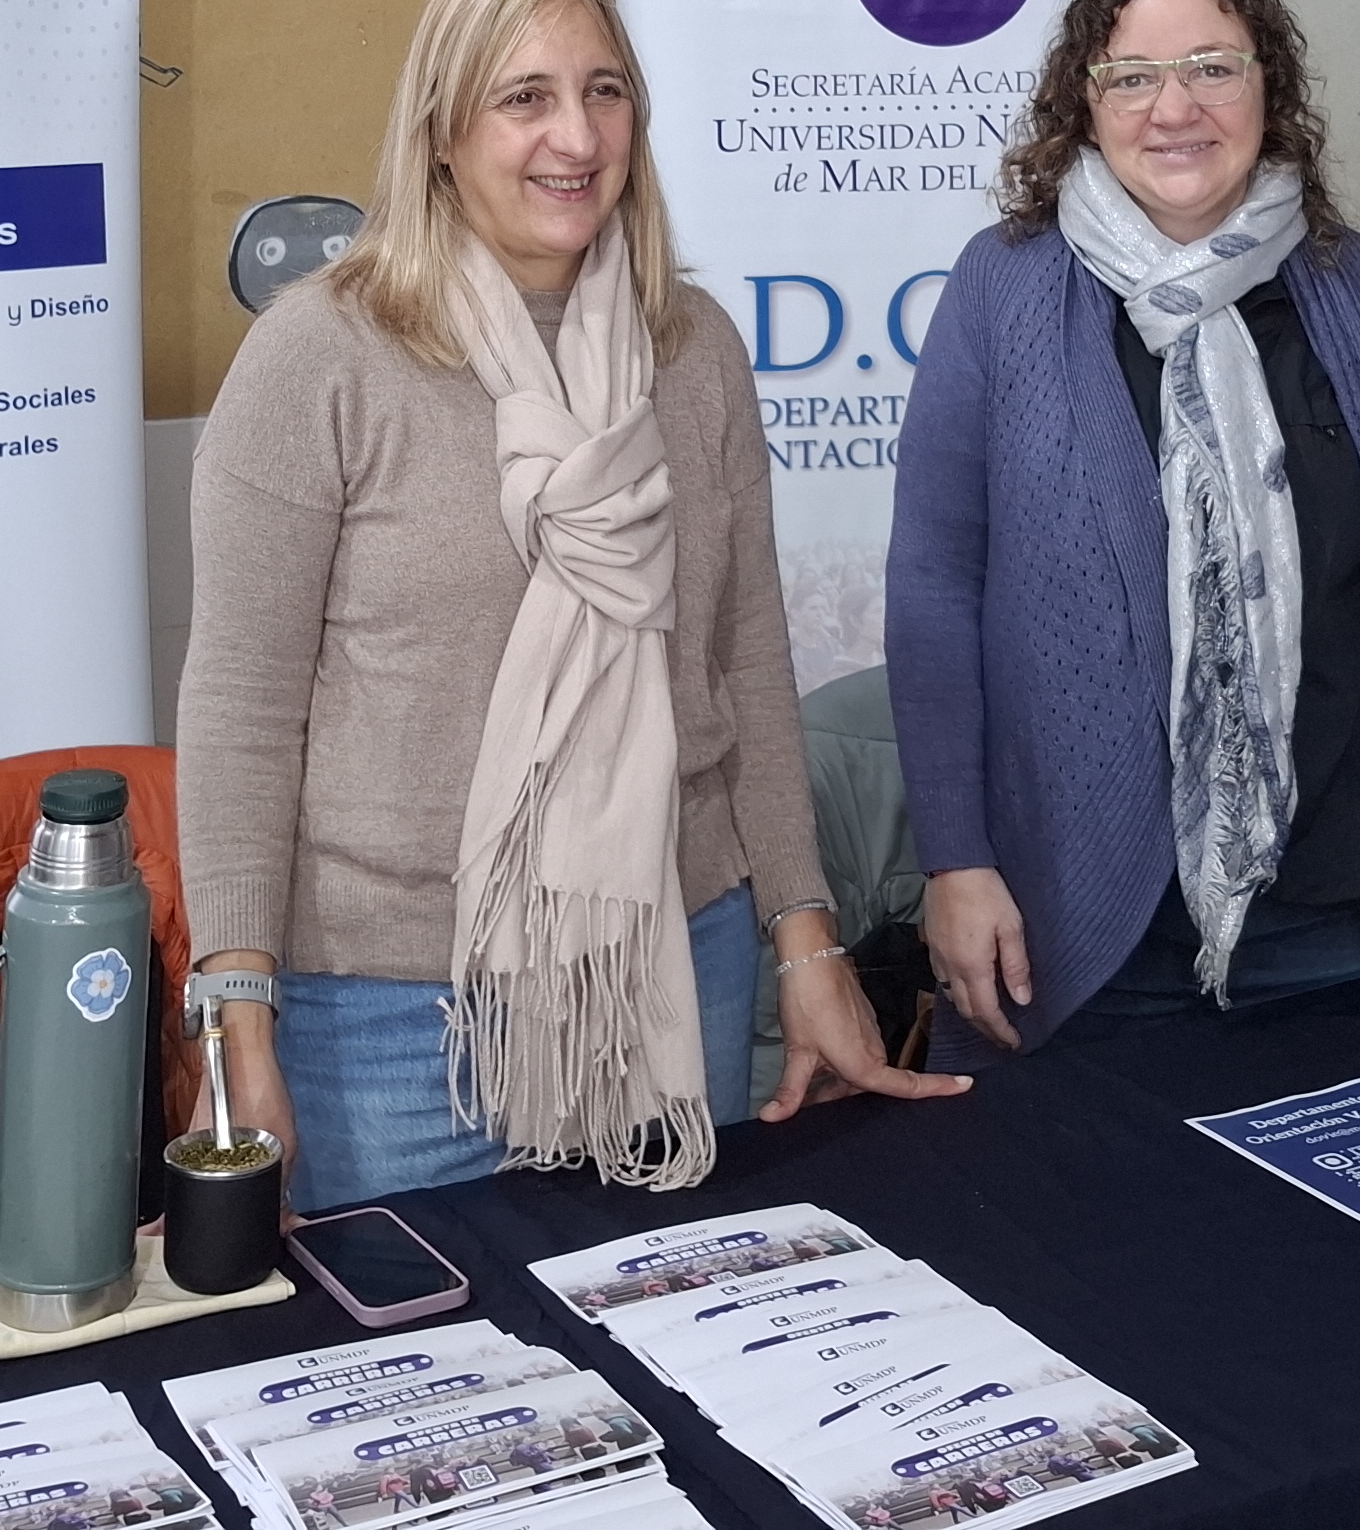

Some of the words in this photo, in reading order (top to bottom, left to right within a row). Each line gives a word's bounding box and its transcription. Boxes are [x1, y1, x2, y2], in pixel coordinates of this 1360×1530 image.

[713, 119, 965, 152] UNIVERSIDAD
[774, 163, 808, 193] de
[819, 159, 910, 193] MAR
[919, 164, 987, 191] DEL
[7, 304, 23, 326] y
[30, 292, 110, 318] Diseño
[1245, 1113, 1348, 1144] Orientación
[663, 1228, 708, 1243] UNMDP
[636, 1237, 753, 1269] CARRERAS
[740, 1276, 786, 1291] UNMDP
[790, 1307, 838, 1324] UNMDP
[318, 1349, 370, 1365] UNMDP
[839, 1338, 887, 1356] UNMDP
[281, 1361, 416, 1398] CARRERAS
[852, 1366, 897, 1388] UNMDP
[330, 1380, 467, 1419] CARRERAS
[899, 1385, 944, 1409] UNMDP
[378, 1415, 519, 1455] CARRERAS
[939, 1415, 987, 1435] UNMDP
[914, 1426, 1042, 1472] CARRERAS
